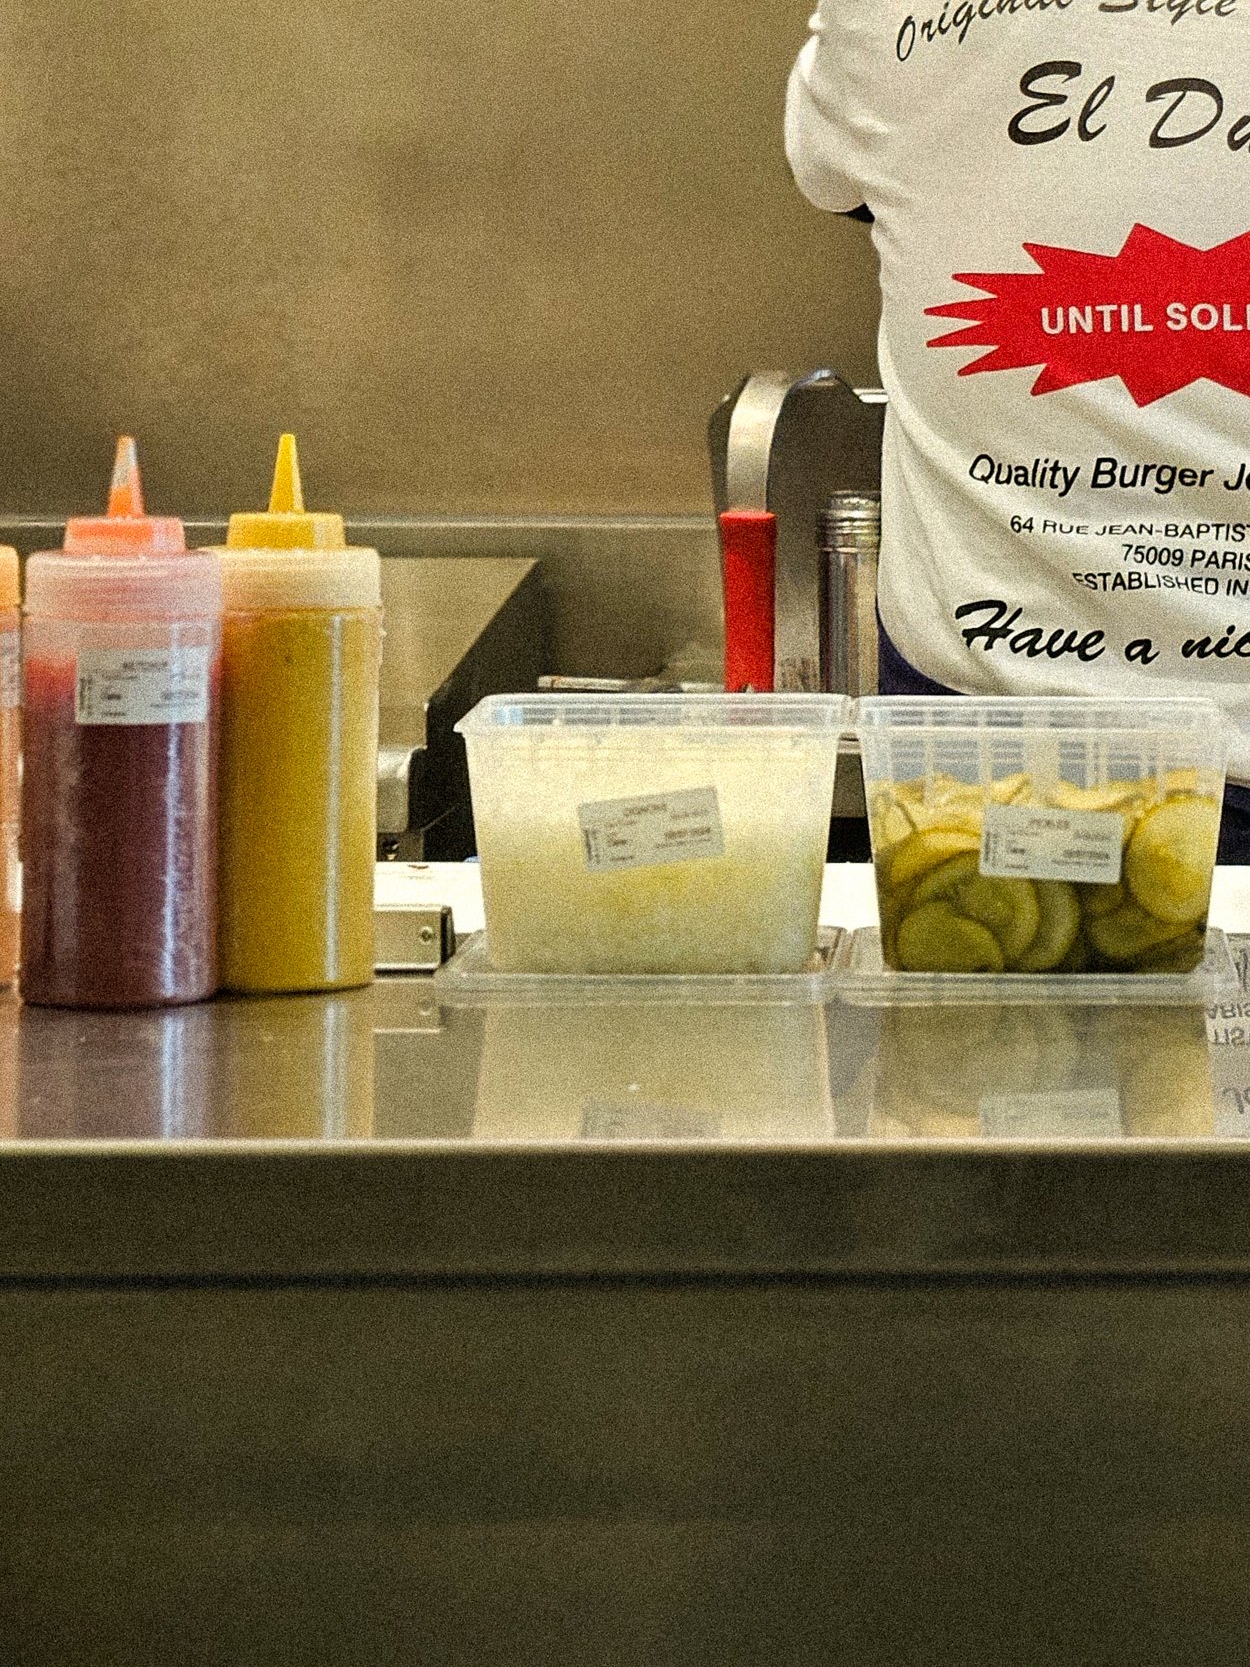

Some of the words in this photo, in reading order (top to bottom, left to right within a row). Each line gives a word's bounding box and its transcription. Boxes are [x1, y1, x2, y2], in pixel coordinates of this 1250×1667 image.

[1007, 60, 1115, 146] El
[1041, 304, 1154, 335] UNTIL
[968, 453, 1081, 498] Quality
[1090, 457, 1214, 496] Burger
[1010, 515, 1034, 534] 64
[1042, 521, 1089, 535] RUE
[1121, 543, 1184, 567] 75009
[1225, 580, 1249, 596] IN
[955, 599, 1105, 662] Have
[1124, 638, 1159, 665] a
